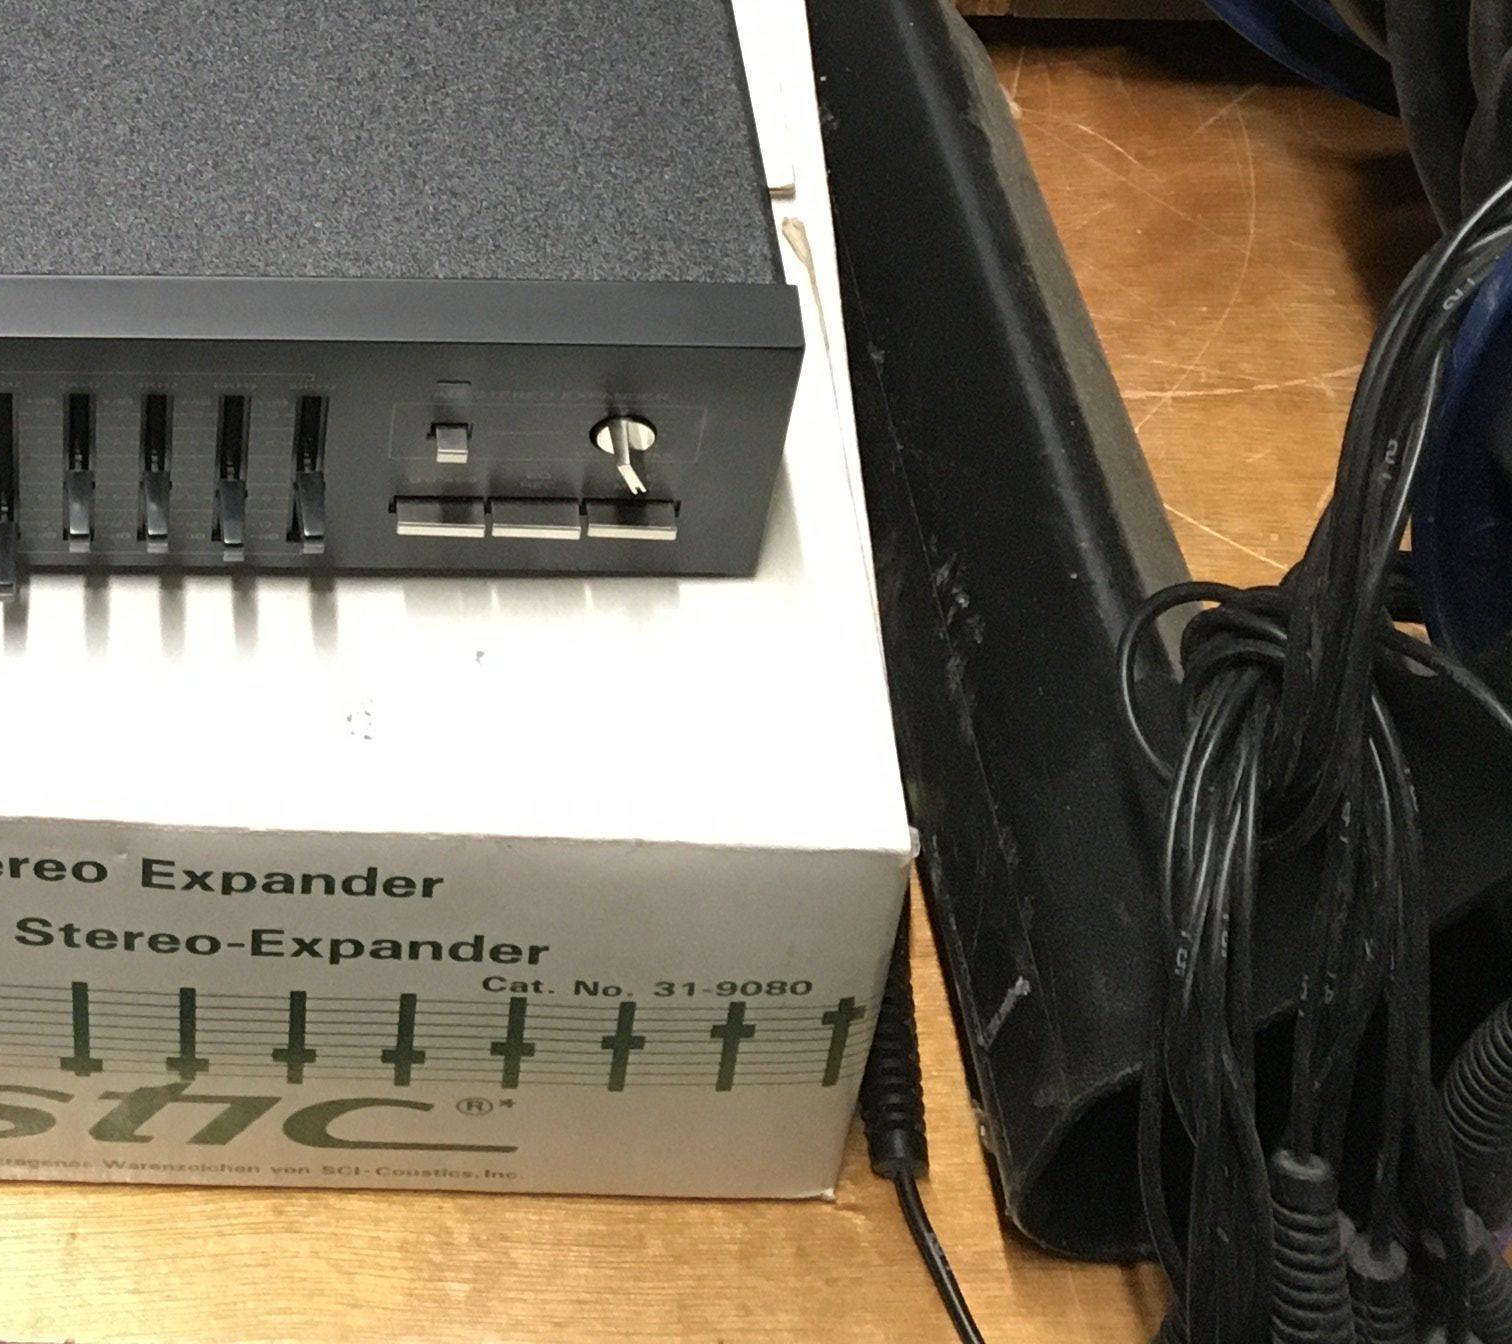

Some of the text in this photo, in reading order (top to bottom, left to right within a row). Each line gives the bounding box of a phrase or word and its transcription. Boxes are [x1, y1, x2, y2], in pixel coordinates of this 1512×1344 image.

[141, 858, 444, 900] Expander
[16, 917, 549, 965] Stereo-Expander
[483, 978, 812, 998] Cat. No. 31-9080
[271, 1165, 309, 1176] von
